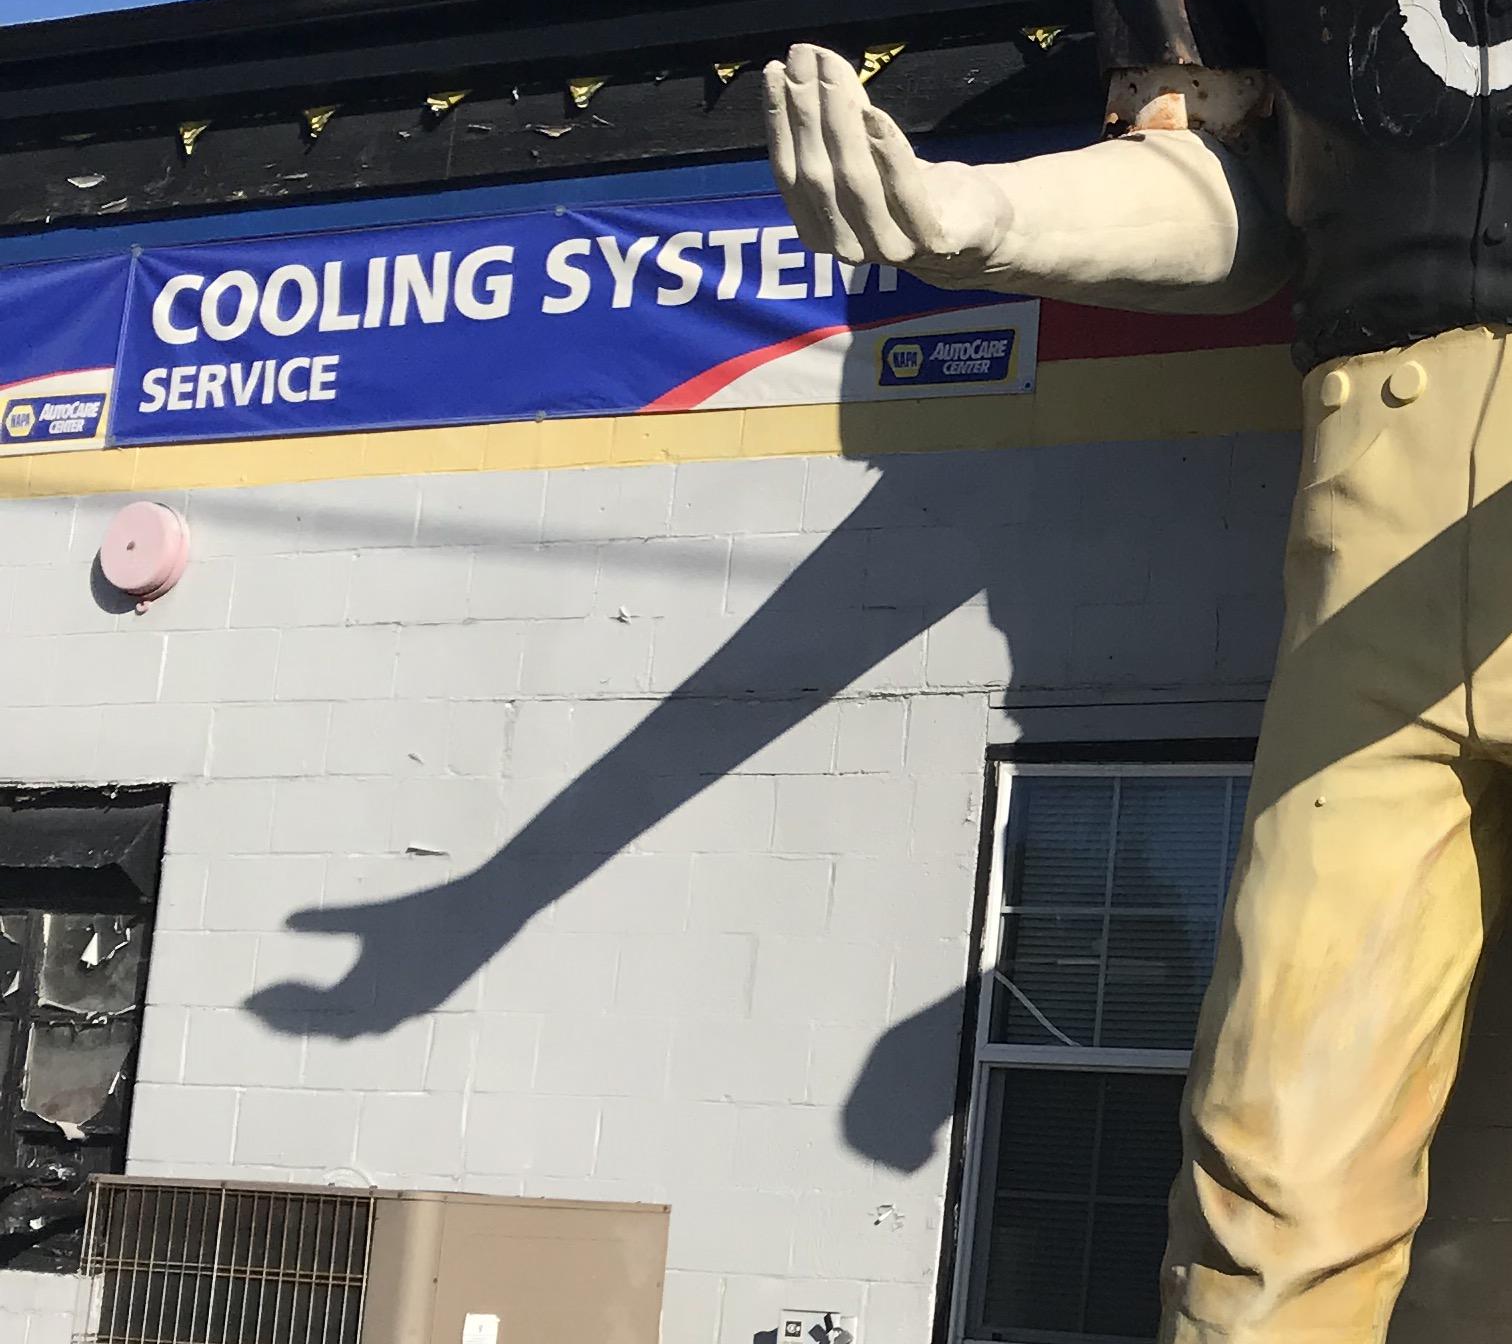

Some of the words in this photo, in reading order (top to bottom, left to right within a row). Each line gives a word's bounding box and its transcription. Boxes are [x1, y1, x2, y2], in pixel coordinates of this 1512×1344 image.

[153, 245, 515, 344] COOLING
[542, 225, 898, 313] SYSTEM
[893, 351, 918, 369] NAPA
[943, 360, 991, 375] CENTER
[139, 355, 339, 413] SERVICE
[48, 419, 85, 434] CENTER
